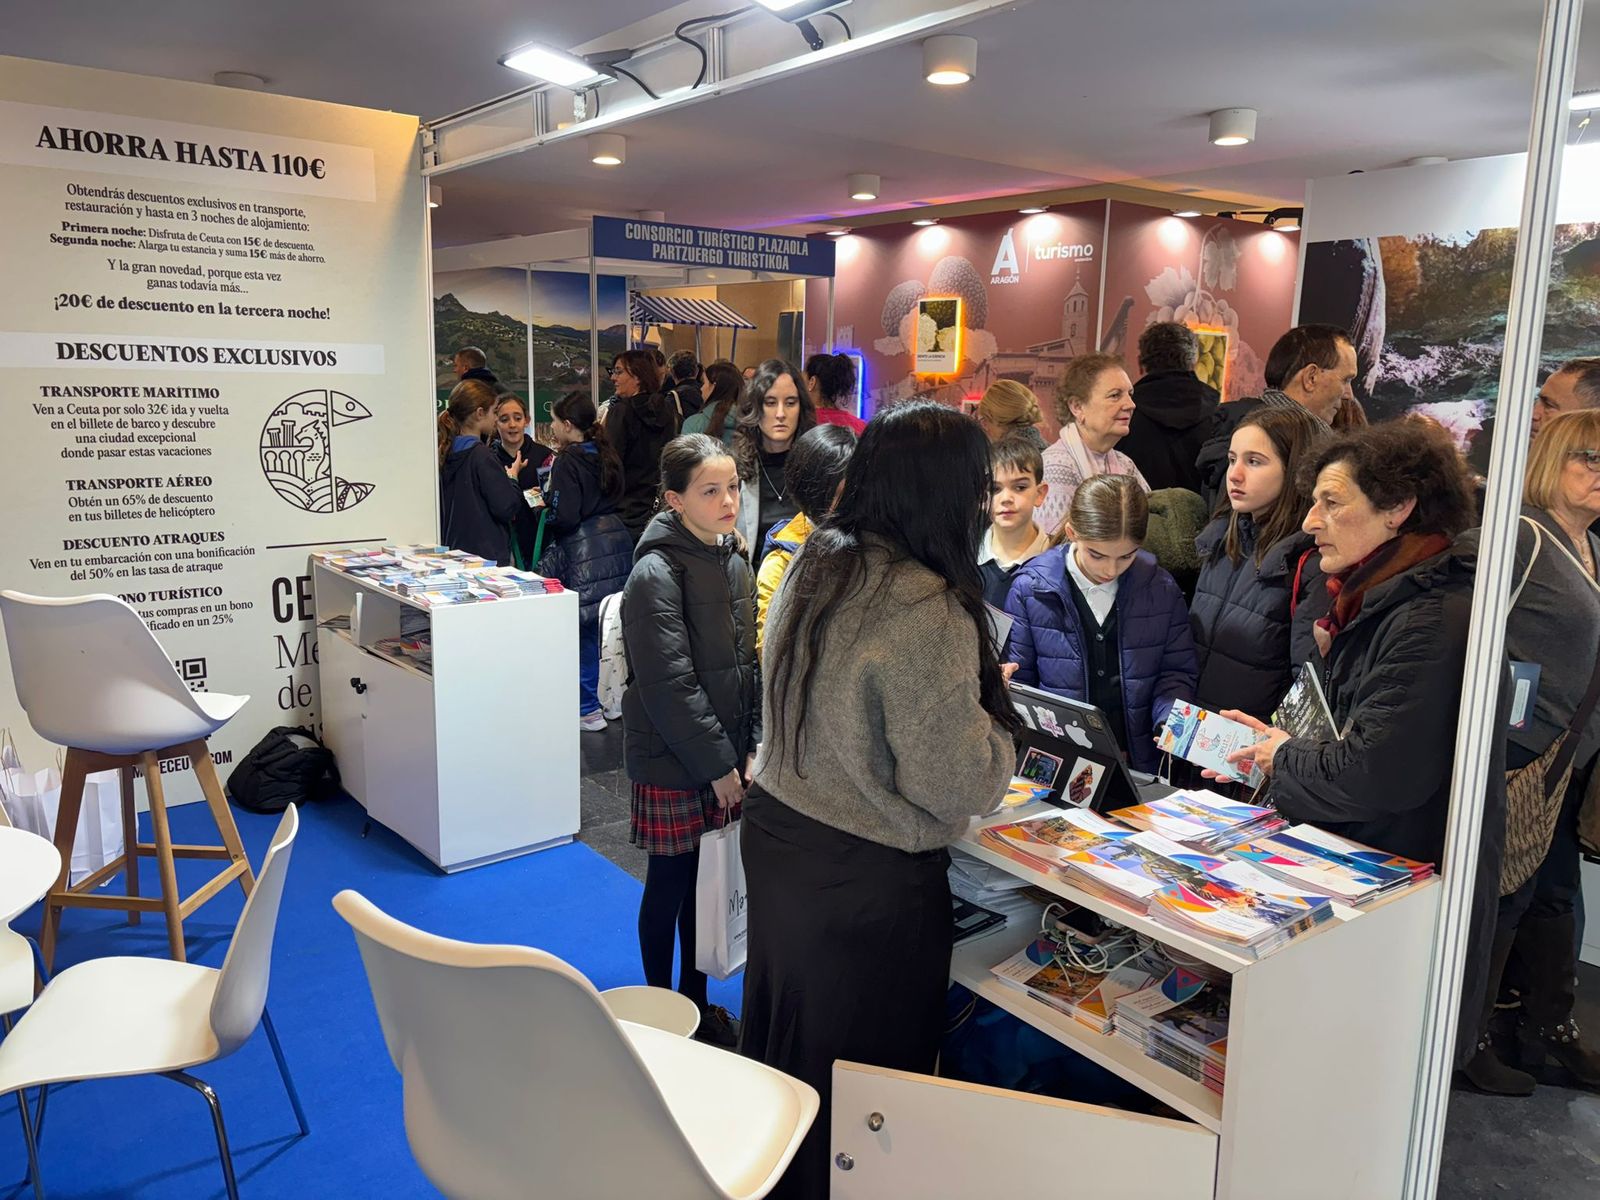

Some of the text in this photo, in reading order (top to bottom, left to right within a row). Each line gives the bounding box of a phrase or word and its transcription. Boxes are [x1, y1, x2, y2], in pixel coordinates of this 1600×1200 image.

[35, 125, 326, 180] AHORRA HASTA 110€
[66, 182, 306, 219] Obtendrás descuentos exclusivos en transporte,
[64, 201, 310, 232] restauración y hasta en 3 noches de alojamiento:
[61, 220, 315, 252] Primera noche: Disfruta de Ceuta con 15€ de descuento.
[625, 222, 809, 256] CONSORCIO TURÍSTICO PLAZAOLA
[49, 232, 326, 264] Segunda noche: Alarga tu estancia y suma 15€ más de ahorro.
[652, 243, 789, 270] PARTZUERGO TURISTIKOA
[1035, 242, 1094, 260] turismo
[106, 258, 282, 282] Y la gran novedad, porque esta vez
[146, 279, 249, 294] ganas todavía más...
[990, 274, 1020, 285] ARAGÓN
[54, 293, 331, 320] ¡20€ de descuento en la tercera noche!
[55, 342, 337, 367] DESCUENTOS EXCLUSIVOS
[39, 385, 220, 399] TRANSPORTE MARÍTIMO
[32, 402, 230, 418] Ven a Ceuta por solo 32€ ida y vuelta
[50, 417, 216, 432] en el billete de barco y descubre
[75, 431, 197, 446] una ciudad excepcional
[60, 445, 212, 461] donde pasar estas vacaciones
[65, 473, 213, 491] TRANSPORTE AÉREO
[68, 493, 214, 508] Obtén un 65% de descuento
[68, 505, 216, 522] en tus billetes de helicóptero
[62, 531, 225, 551] DESCUENTO ATRAQUES
[29, 545, 256, 570] Ven en tu embarcación con una bonificación
[70, 562, 224, 581] del 50% en las tasa de atraque
[116, 586, 223, 604] ONO TURÍSTICO
[155, 606, 199, 618] compras
[200, 604, 213, 613] en
[214, 603, 228, 612] un
[229, 600, 254, 611] bono
[182, 619, 195, 628] en
[196, 618, 210, 627] un
[211, 613, 234, 625] 25%
[277, 674, 313, 711] de
